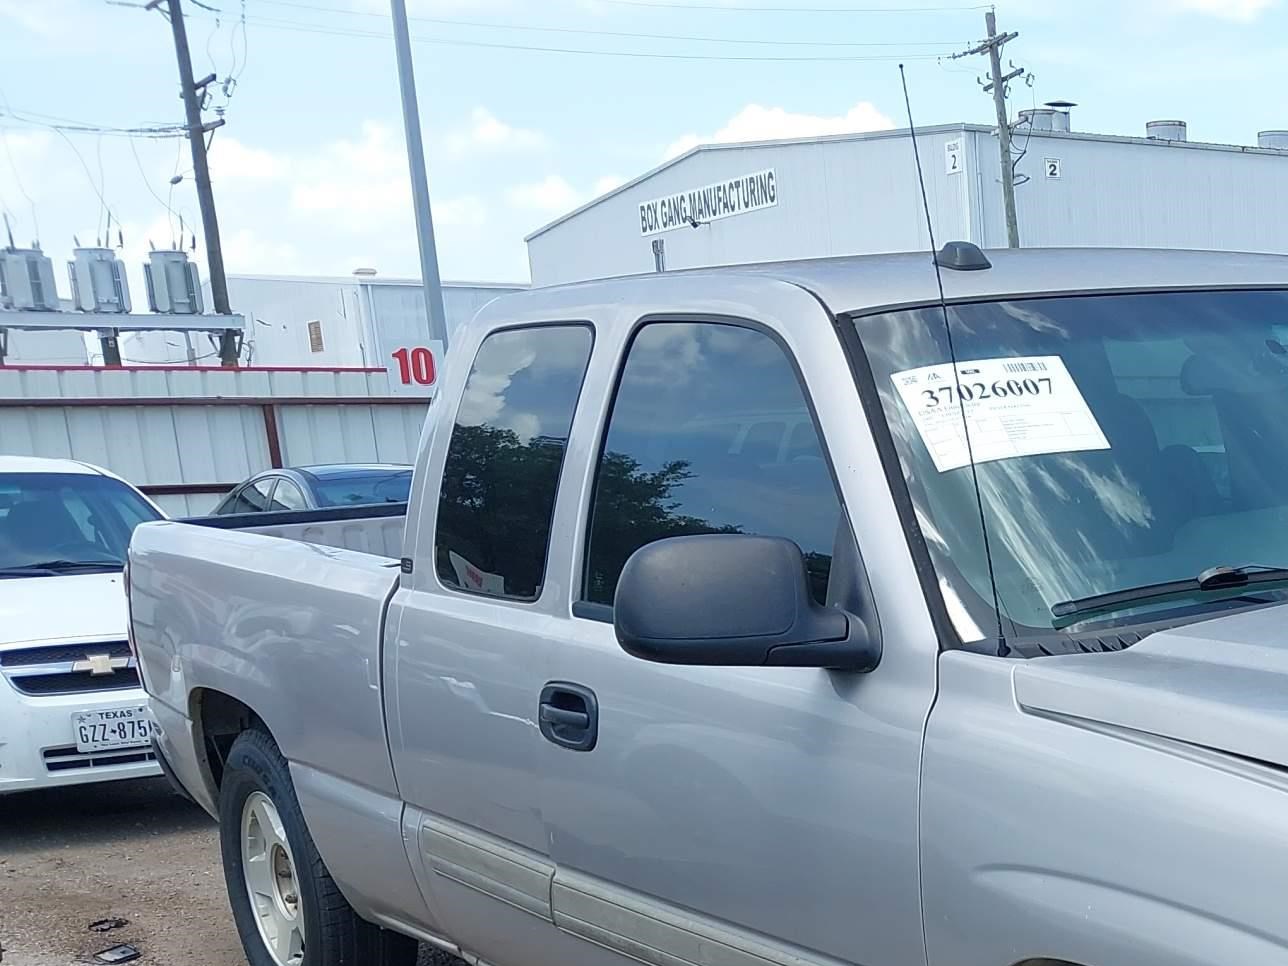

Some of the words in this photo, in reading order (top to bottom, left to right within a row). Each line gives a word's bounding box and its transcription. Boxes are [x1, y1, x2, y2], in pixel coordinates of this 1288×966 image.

[951, 154, 958, 170] 2
[1048, 163, 1058, 176] 2
[639, 201, 660, 233] BOX
[660, 195, 688, 229] GANG
[687, 171, 776, 221] MANUFACTURING
[391, 347, 437, 386] 10
[921, 377, 1054, 408] 37026007
[98, 709, 133, 721] TEXAS
